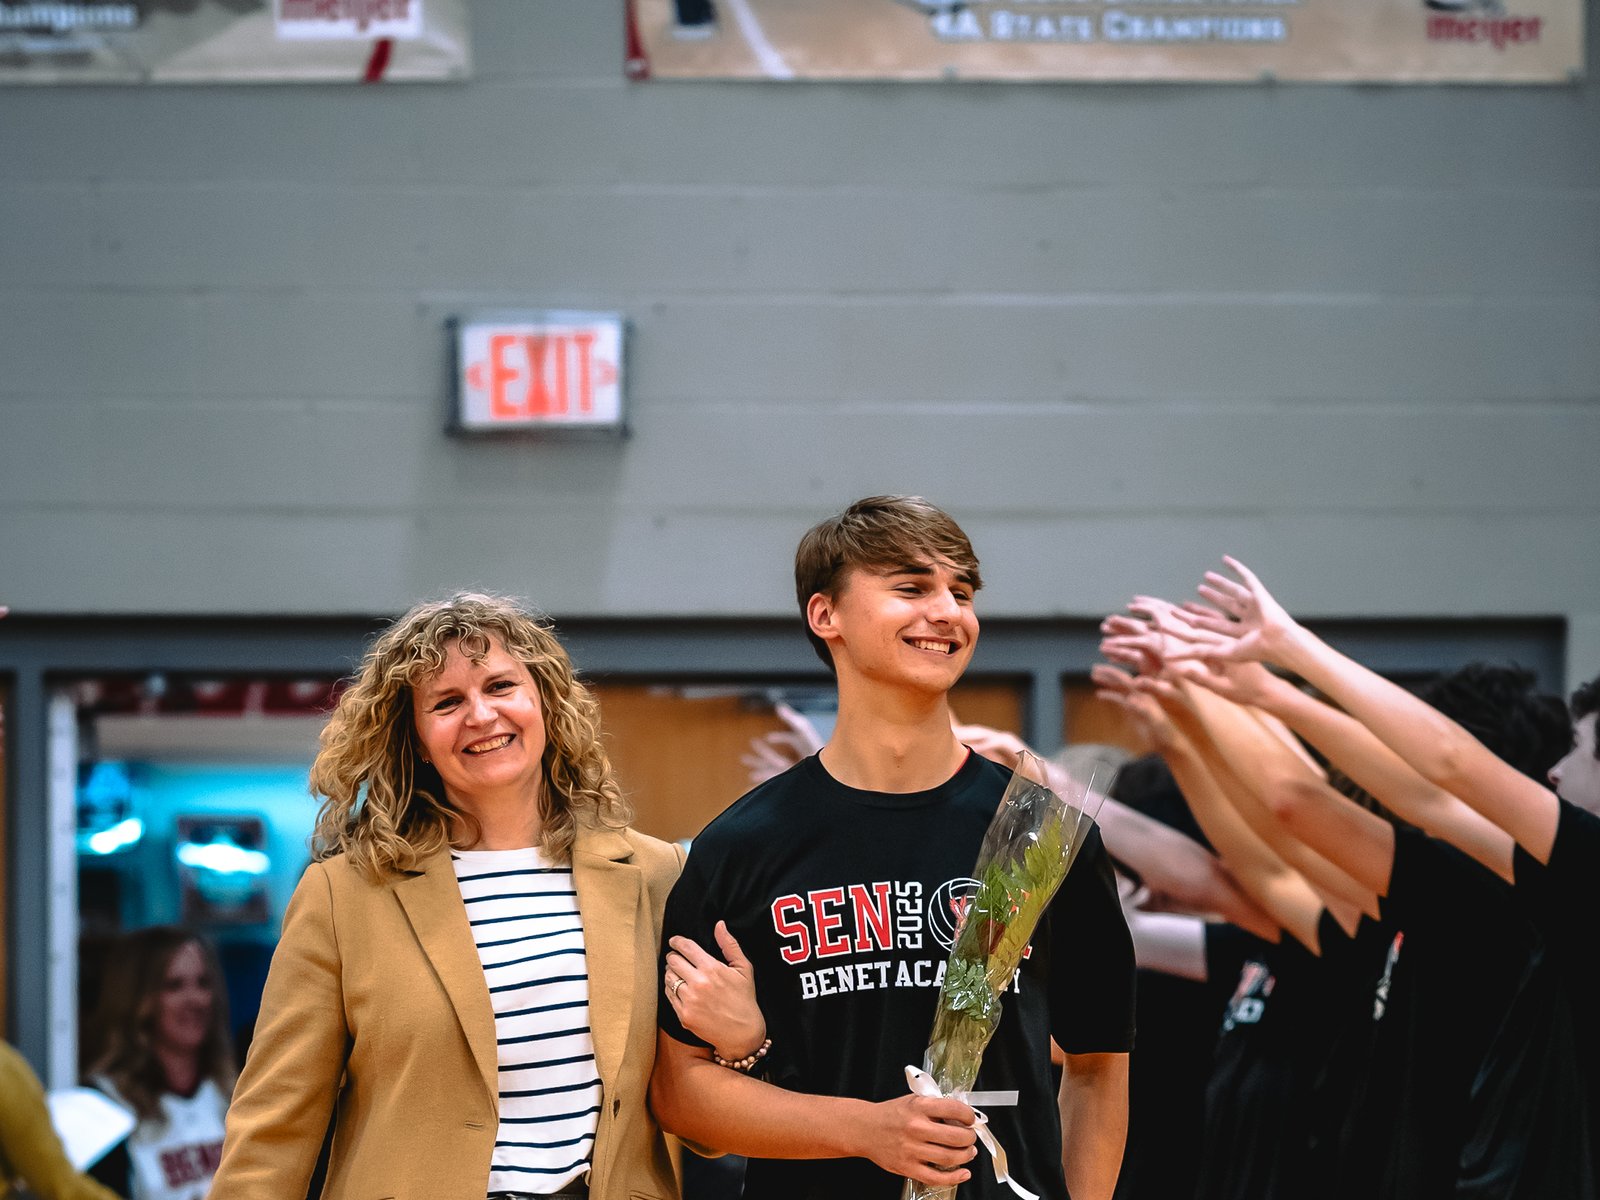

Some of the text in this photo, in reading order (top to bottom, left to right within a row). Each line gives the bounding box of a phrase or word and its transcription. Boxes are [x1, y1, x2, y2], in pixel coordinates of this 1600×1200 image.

[1427, 16, 1541, 52] meijer
[490, 333, 596, 419] EXIT
[895, 880, 923, 949] 2025
[800, 960, 892, 1000] BENET
